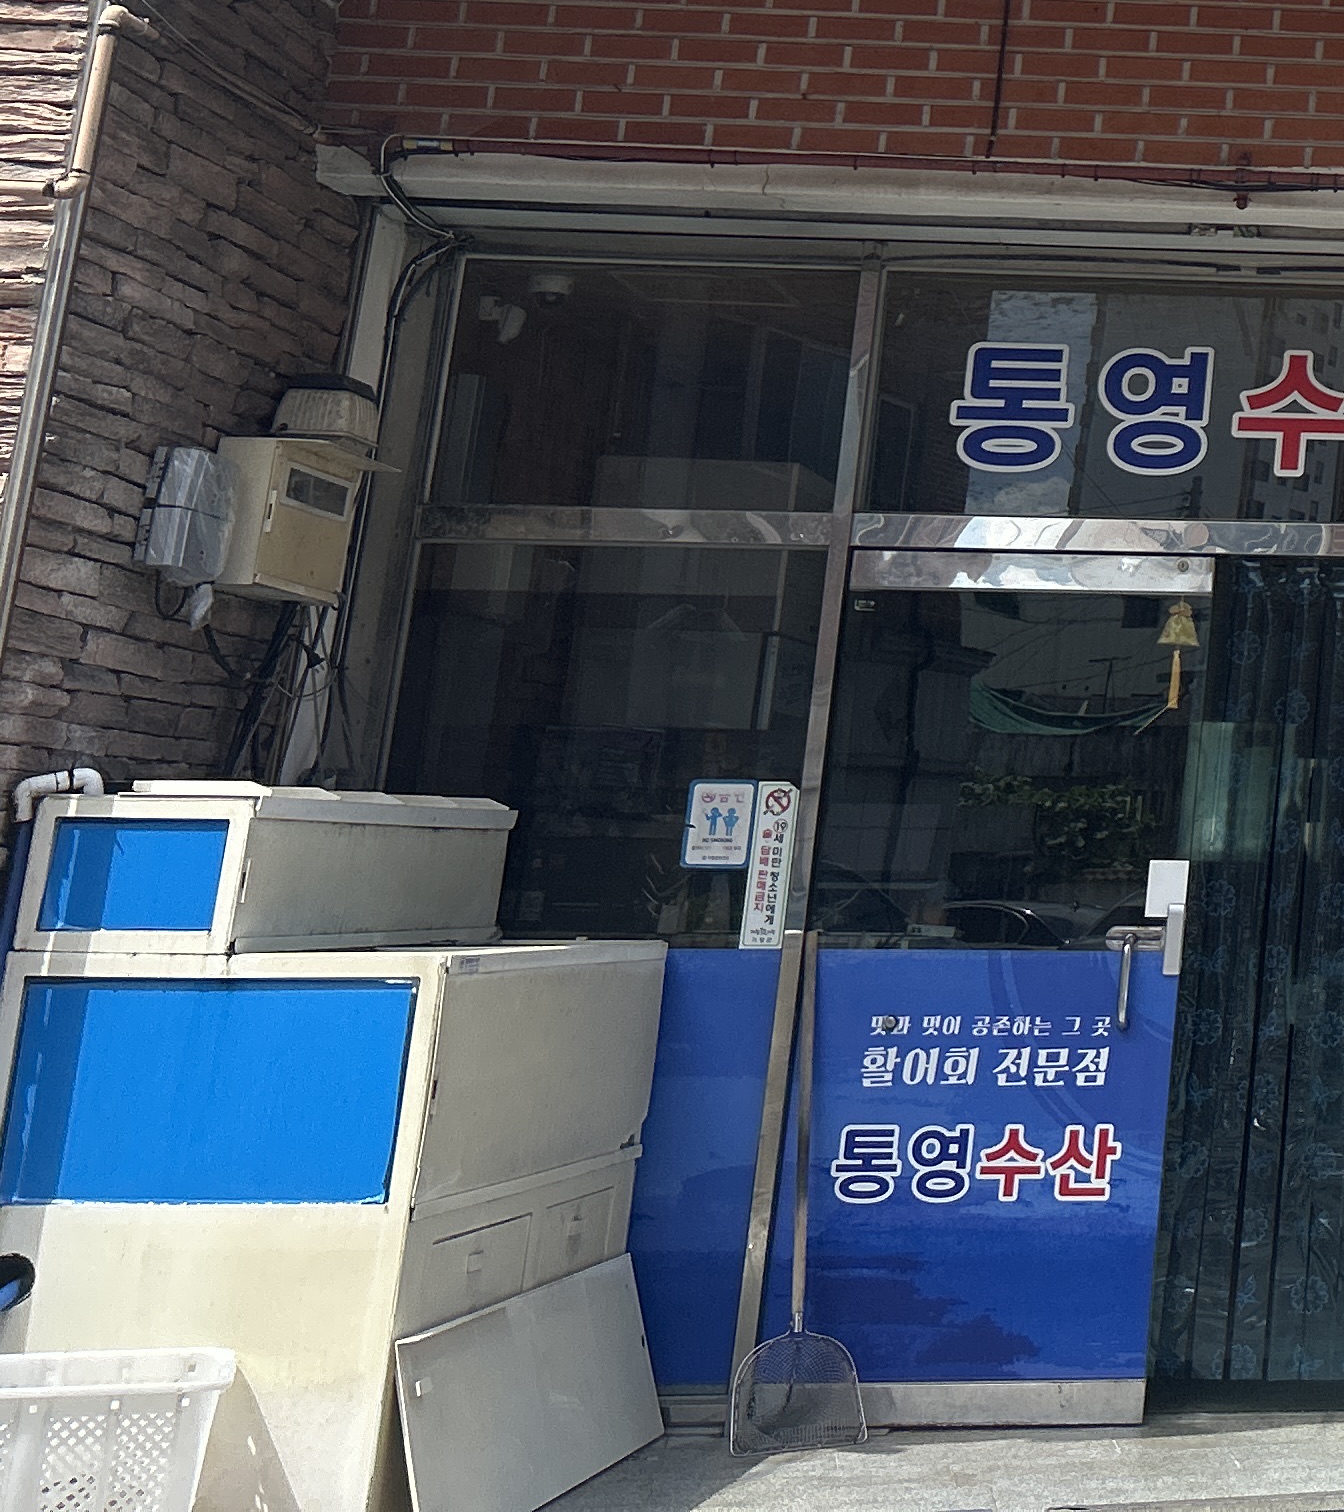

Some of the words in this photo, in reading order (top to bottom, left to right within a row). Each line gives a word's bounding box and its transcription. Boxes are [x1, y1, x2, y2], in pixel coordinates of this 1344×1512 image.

[971, 1016, 1052, 1036] 공존하는
[1061, 1016, 1082, 1036] 그
[1091, 1016, 1112, 1037] 곳
[861, 1046, 980, 1088] 활어회
[992, 1046, 1110, 1087] 전문점
[831, 1123, 1122, 1203] 통영수산
